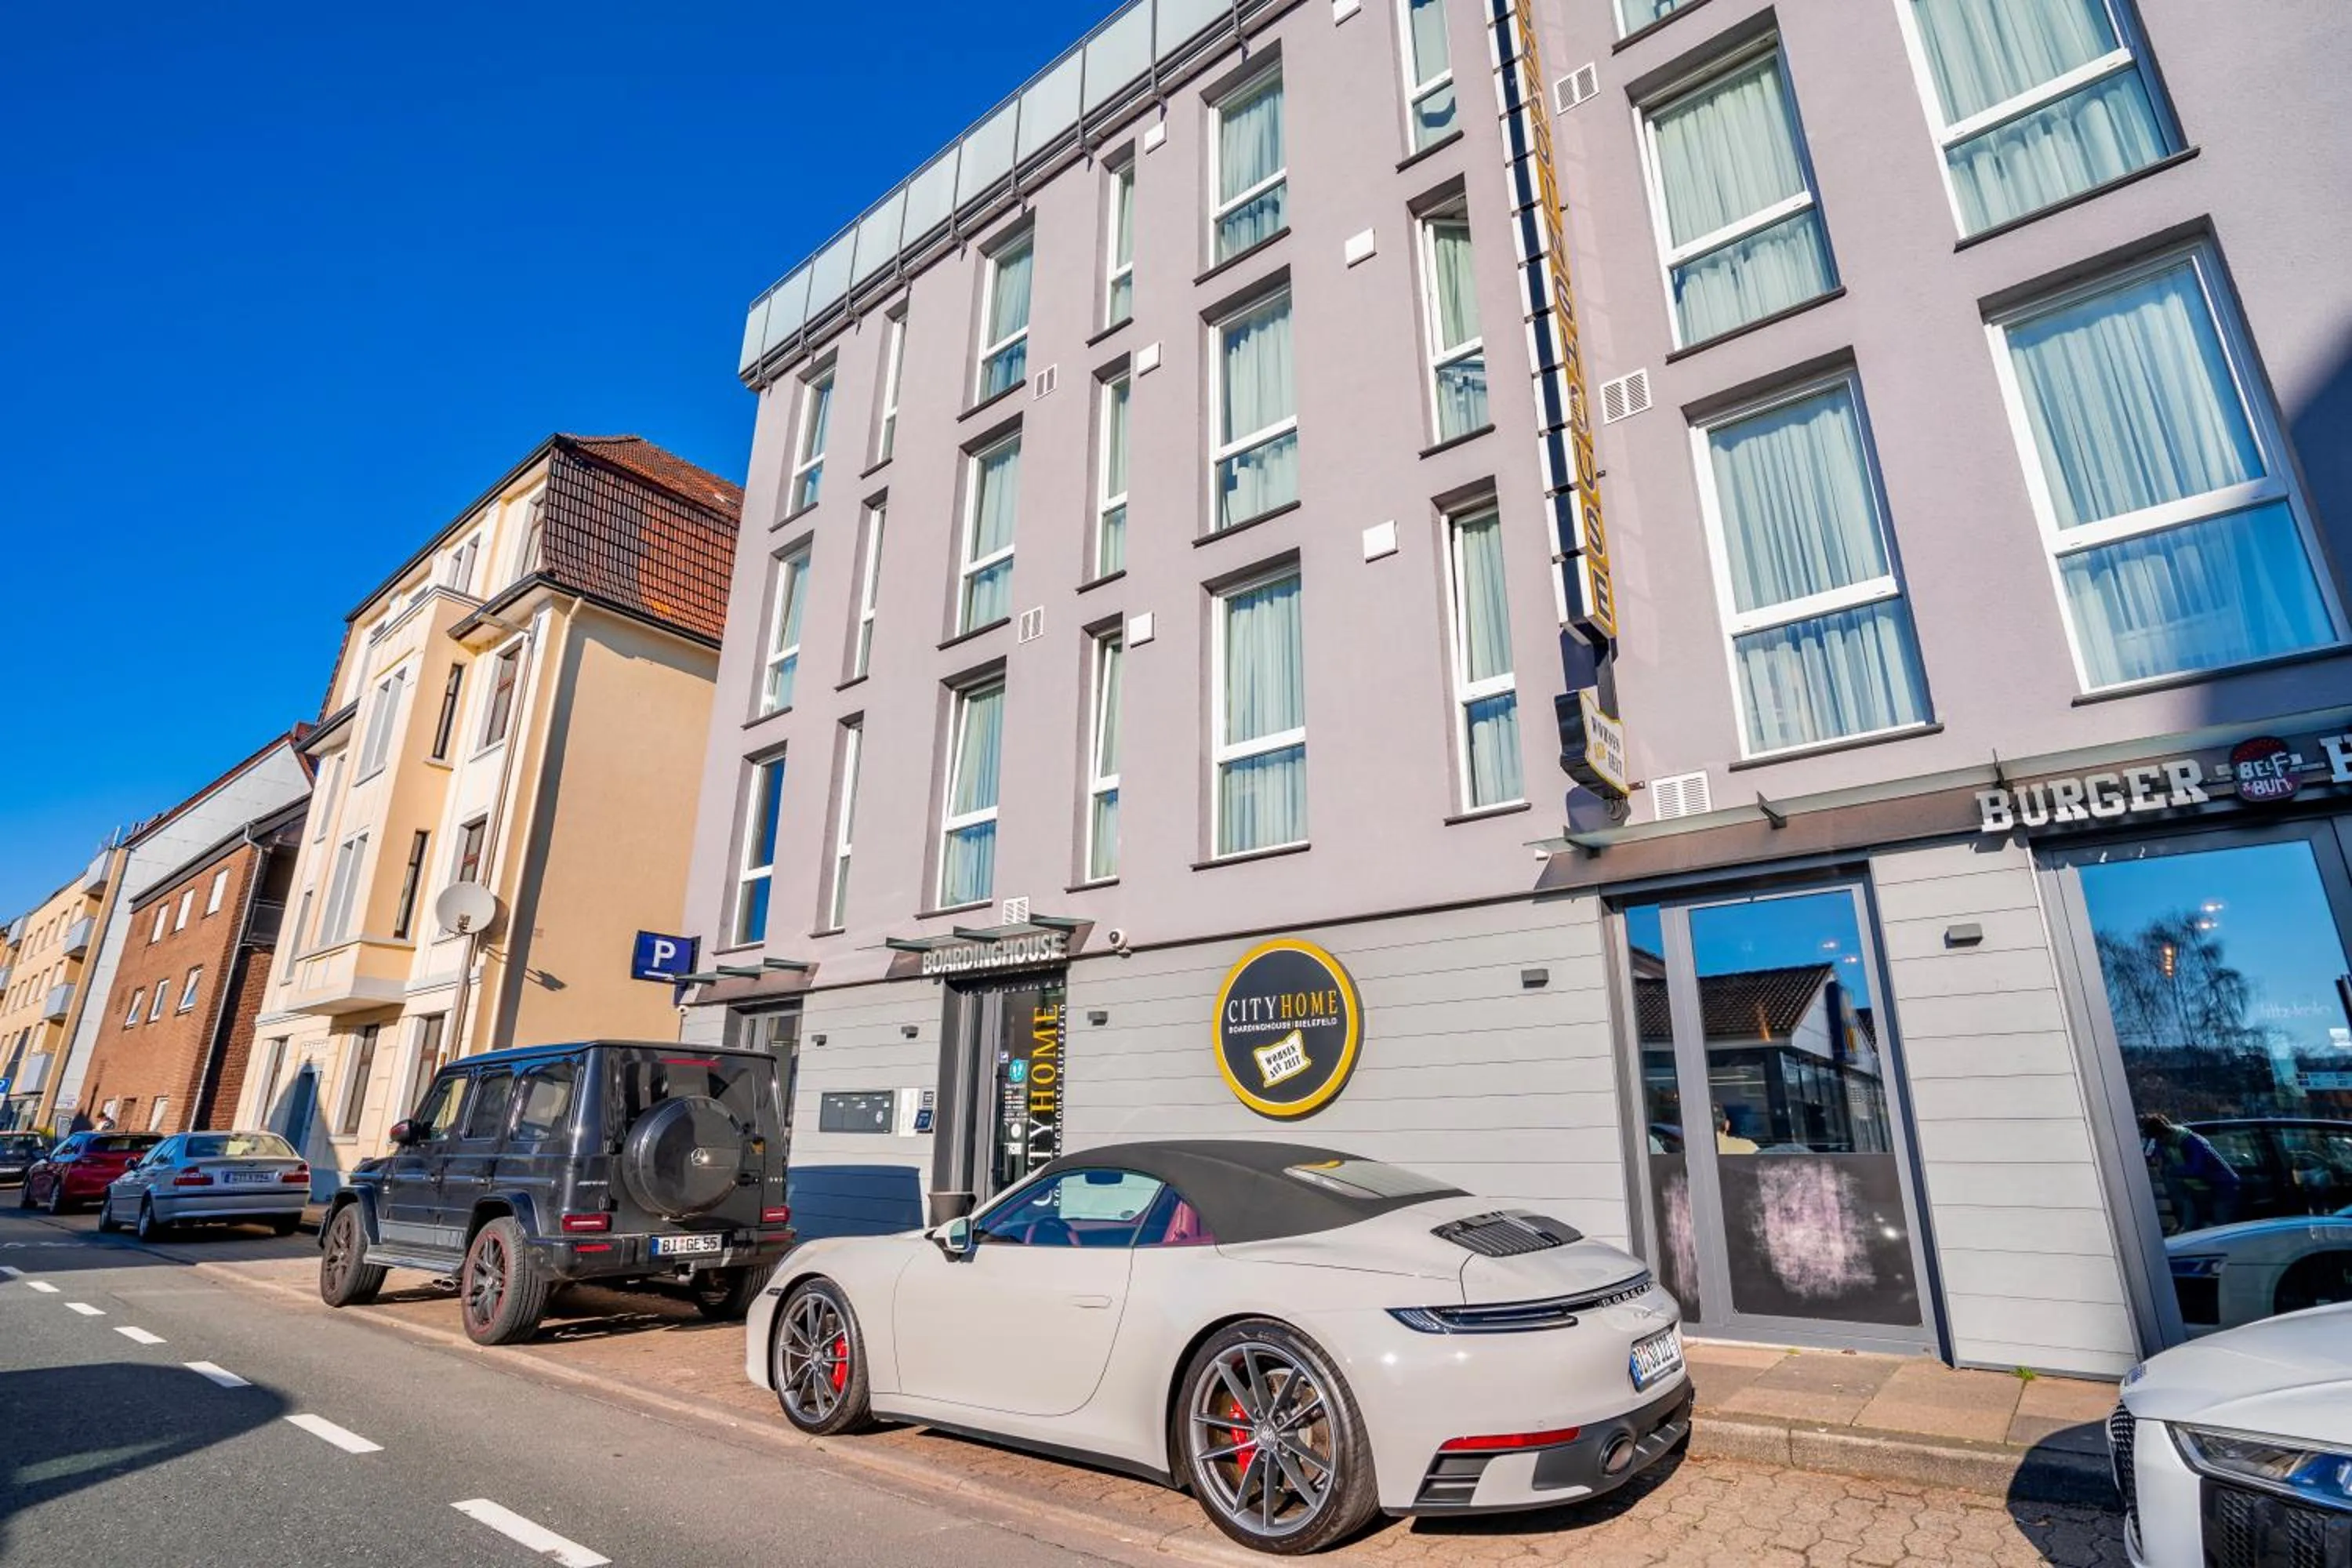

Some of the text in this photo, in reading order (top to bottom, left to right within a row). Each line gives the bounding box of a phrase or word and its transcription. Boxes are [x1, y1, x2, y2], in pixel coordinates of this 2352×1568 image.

[1975, 757, 2210, 833] BURGER
[652, 940, 677, 968] P
[922, 931, 1067, 975] BOARDINGHOUSE
